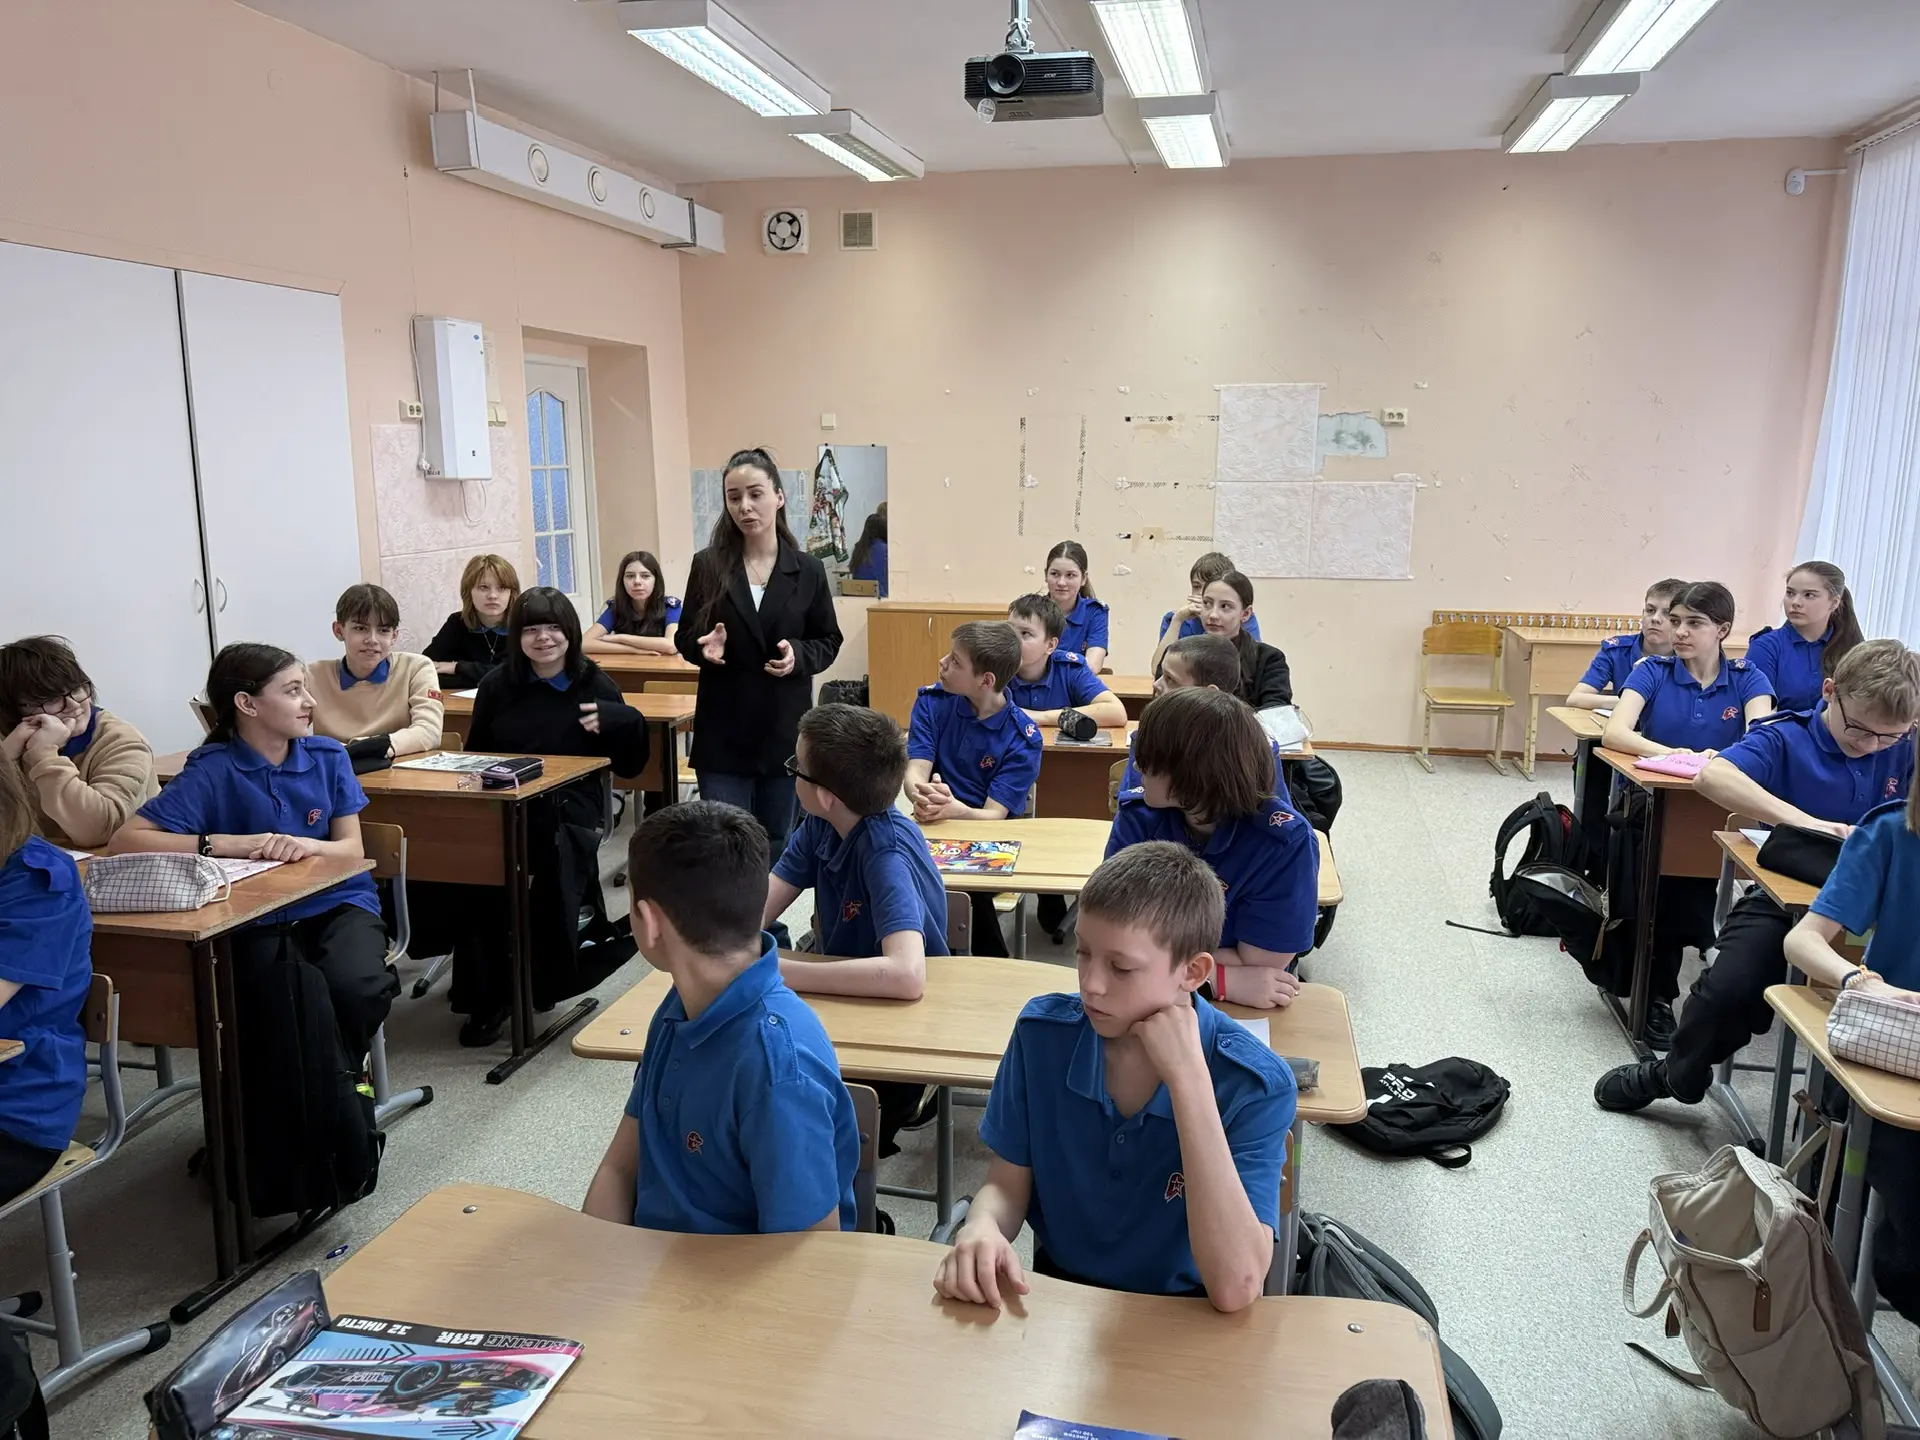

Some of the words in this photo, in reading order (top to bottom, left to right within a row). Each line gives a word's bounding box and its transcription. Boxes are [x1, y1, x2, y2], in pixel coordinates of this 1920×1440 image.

[1382, 1072, 1417, 1099] PRO
[336, 1317, 388, 1332] ЛИСТА
[387, 1324, 413, 1336] 32
[435, 1331, 485, 1346] CAR
[483, 1334, 569, 1353] RACING
